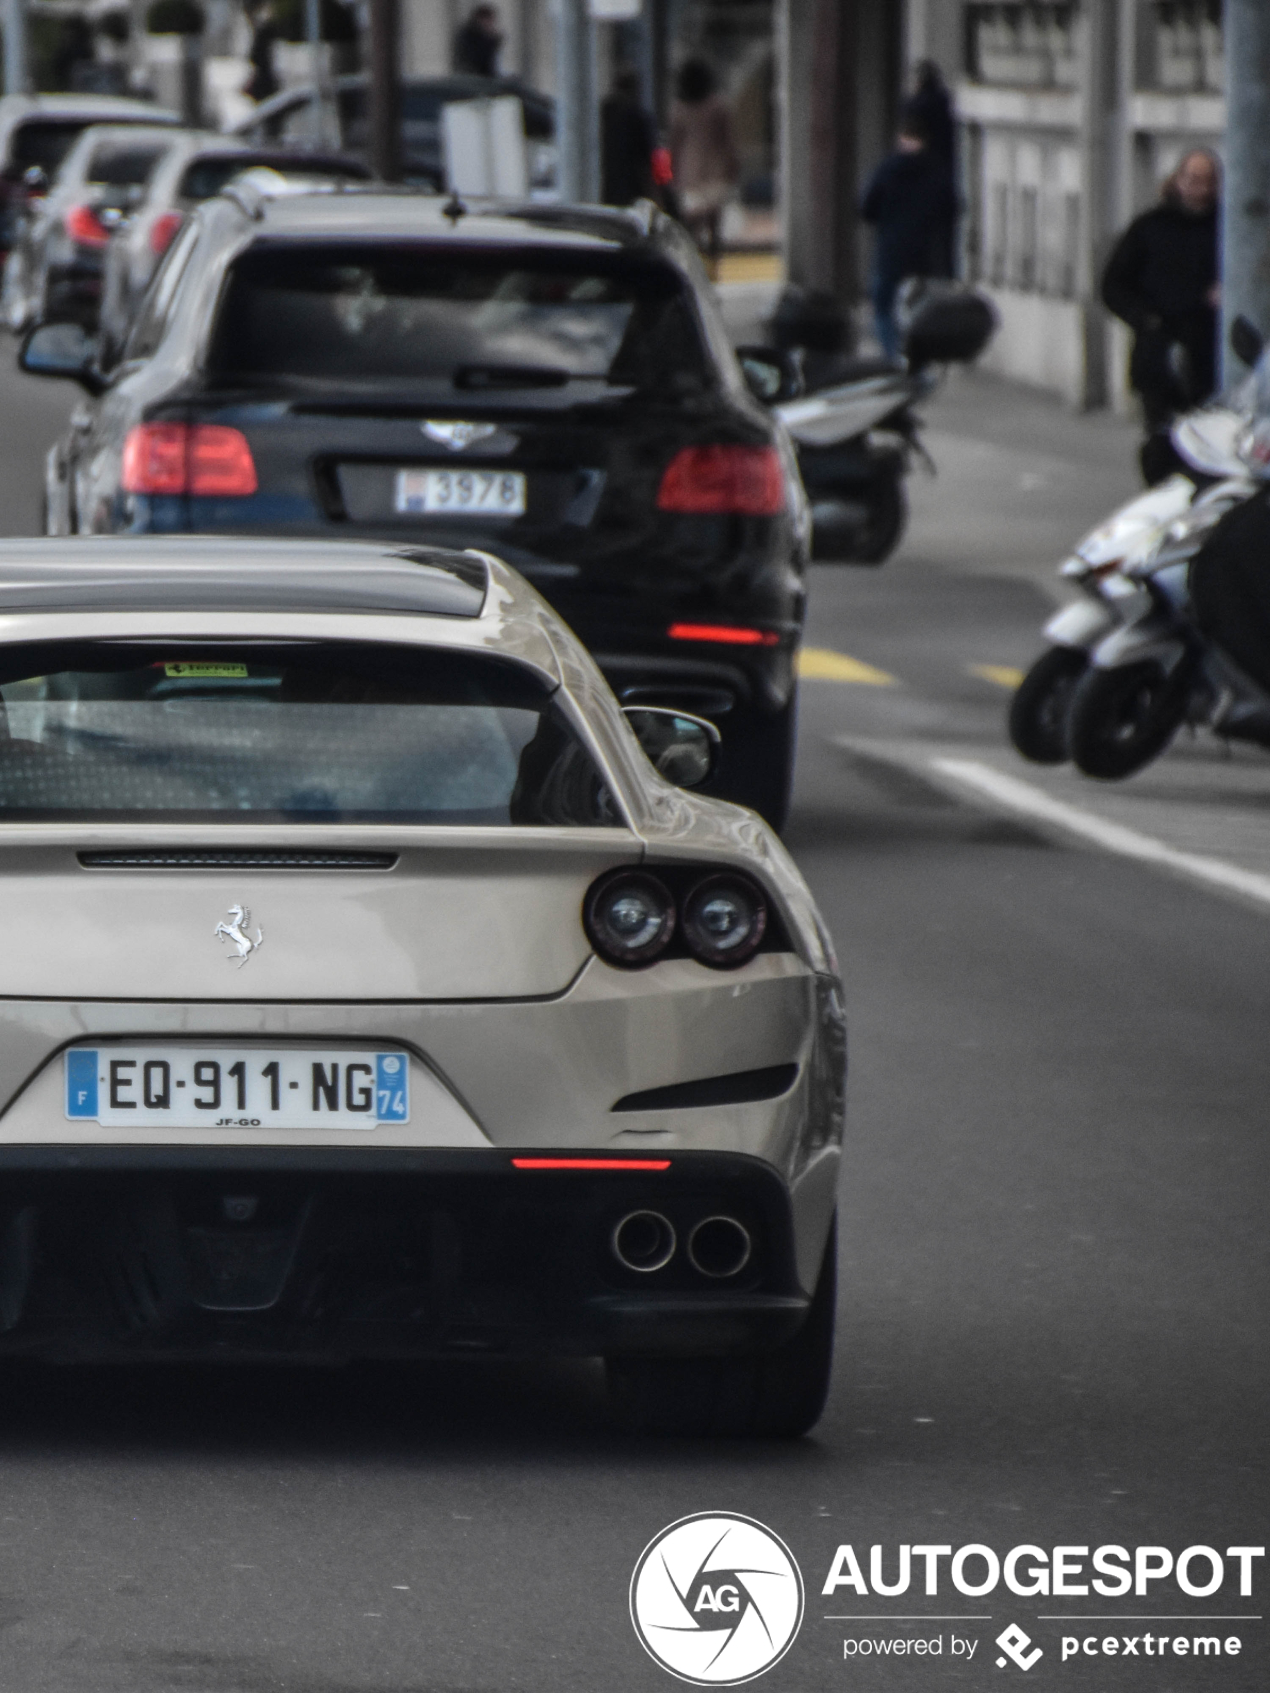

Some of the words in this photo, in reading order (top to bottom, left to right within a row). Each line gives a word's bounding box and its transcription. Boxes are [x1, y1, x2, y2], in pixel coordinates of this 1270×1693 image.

[436, 472, 517, 504] 3978
[77, 1091, 88, 1105] F
[377, 1090, 406, 1115] 74
[215, 1118, 261, 1127] JF-GO
